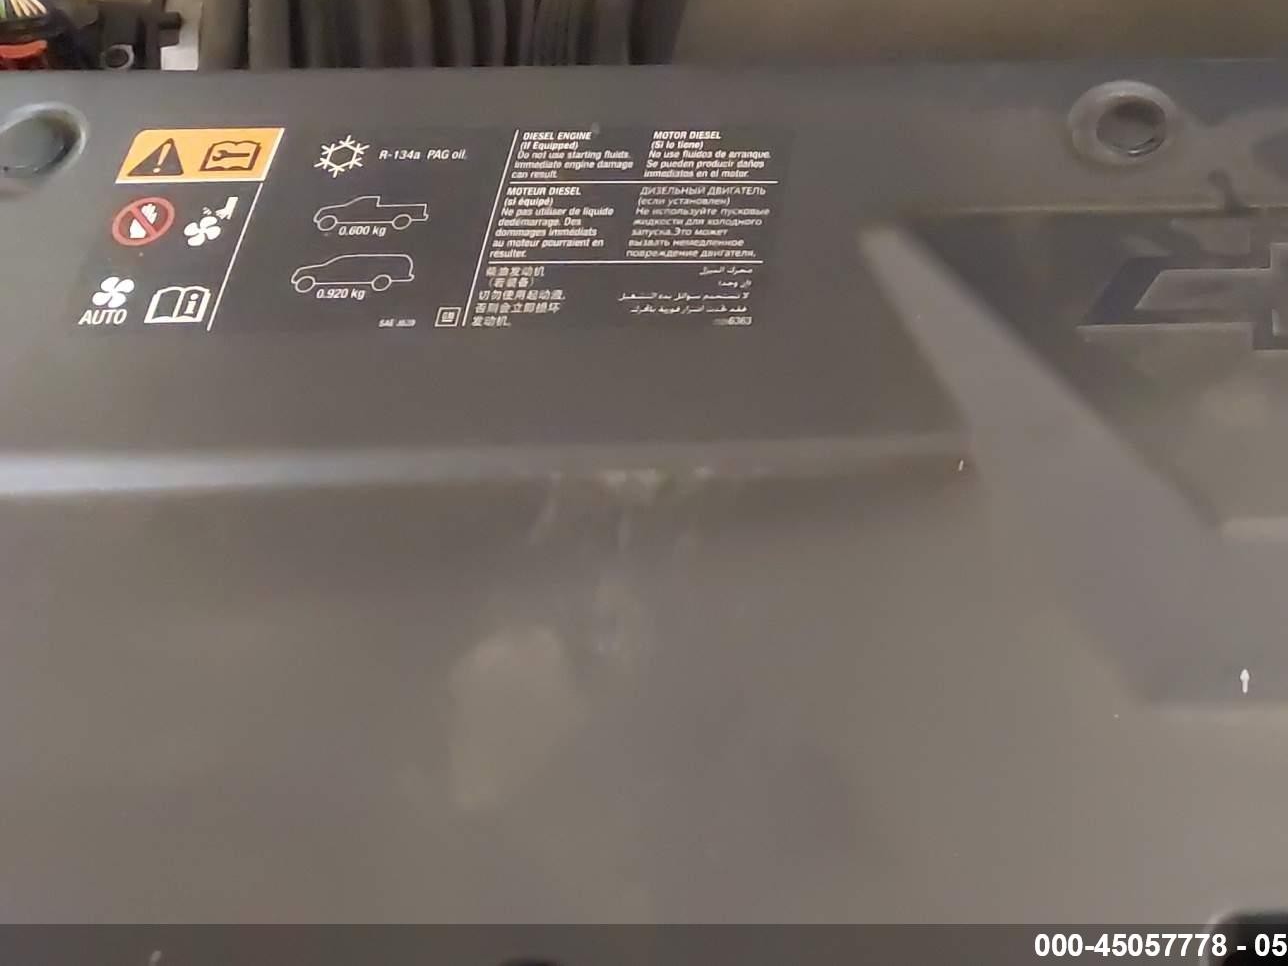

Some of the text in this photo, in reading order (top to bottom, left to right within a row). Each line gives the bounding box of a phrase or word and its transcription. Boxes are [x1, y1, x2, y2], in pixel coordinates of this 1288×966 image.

[523, 131, 592, 140] DIESEL ENGINE
[653, 131, 722, 139] MOTOR DIESEL
[533, 141, 579, 151] Equipped)
[666, 141, 675, 150] lo
[677, 141, 704, 150] tiene)
[379, 149, 421, 160] R-134a
[427, 149, 449, 160] PAG
[517, 151, 530, 160] Do
[531, 151, 546, 160] not
[548, 151, 565, 160] use
[567, 151, 601, 160] starting
[648, 150, 771, 159] No use fluidos de arranque.
[563, 161, 595, 170] engine
[596, 161, 634, 170] damage
[646, 159, 659, 169] Se
[660, 159, 694, 169] pueden
[736, 159, 765, 169] daños
[696, 170, 708, 178] en
[710, 170, 719, 178] el
[721, 170, 749, 178] motor.
[507, 187, 581, 196] MOTEUR DIESEL
[707, 186, 767, 195] ДВИГАТЕЛЬ
[518, 197, 554, 206] équipé)
[638, 197, 731, 206] (если установлен)
[501, 207, 615, 216] Ne pas utiliser de liquide
[636, 208, 650, 216] Не
[564, 217, 582, 226] Des
[338, 225, 387, 237] 0.600 kg
[492, 239, 604, 248] au moteur pourraient en
[316, 288, 366, 300] 0.920 kg
[78, 309, 128, 325] AUTO
